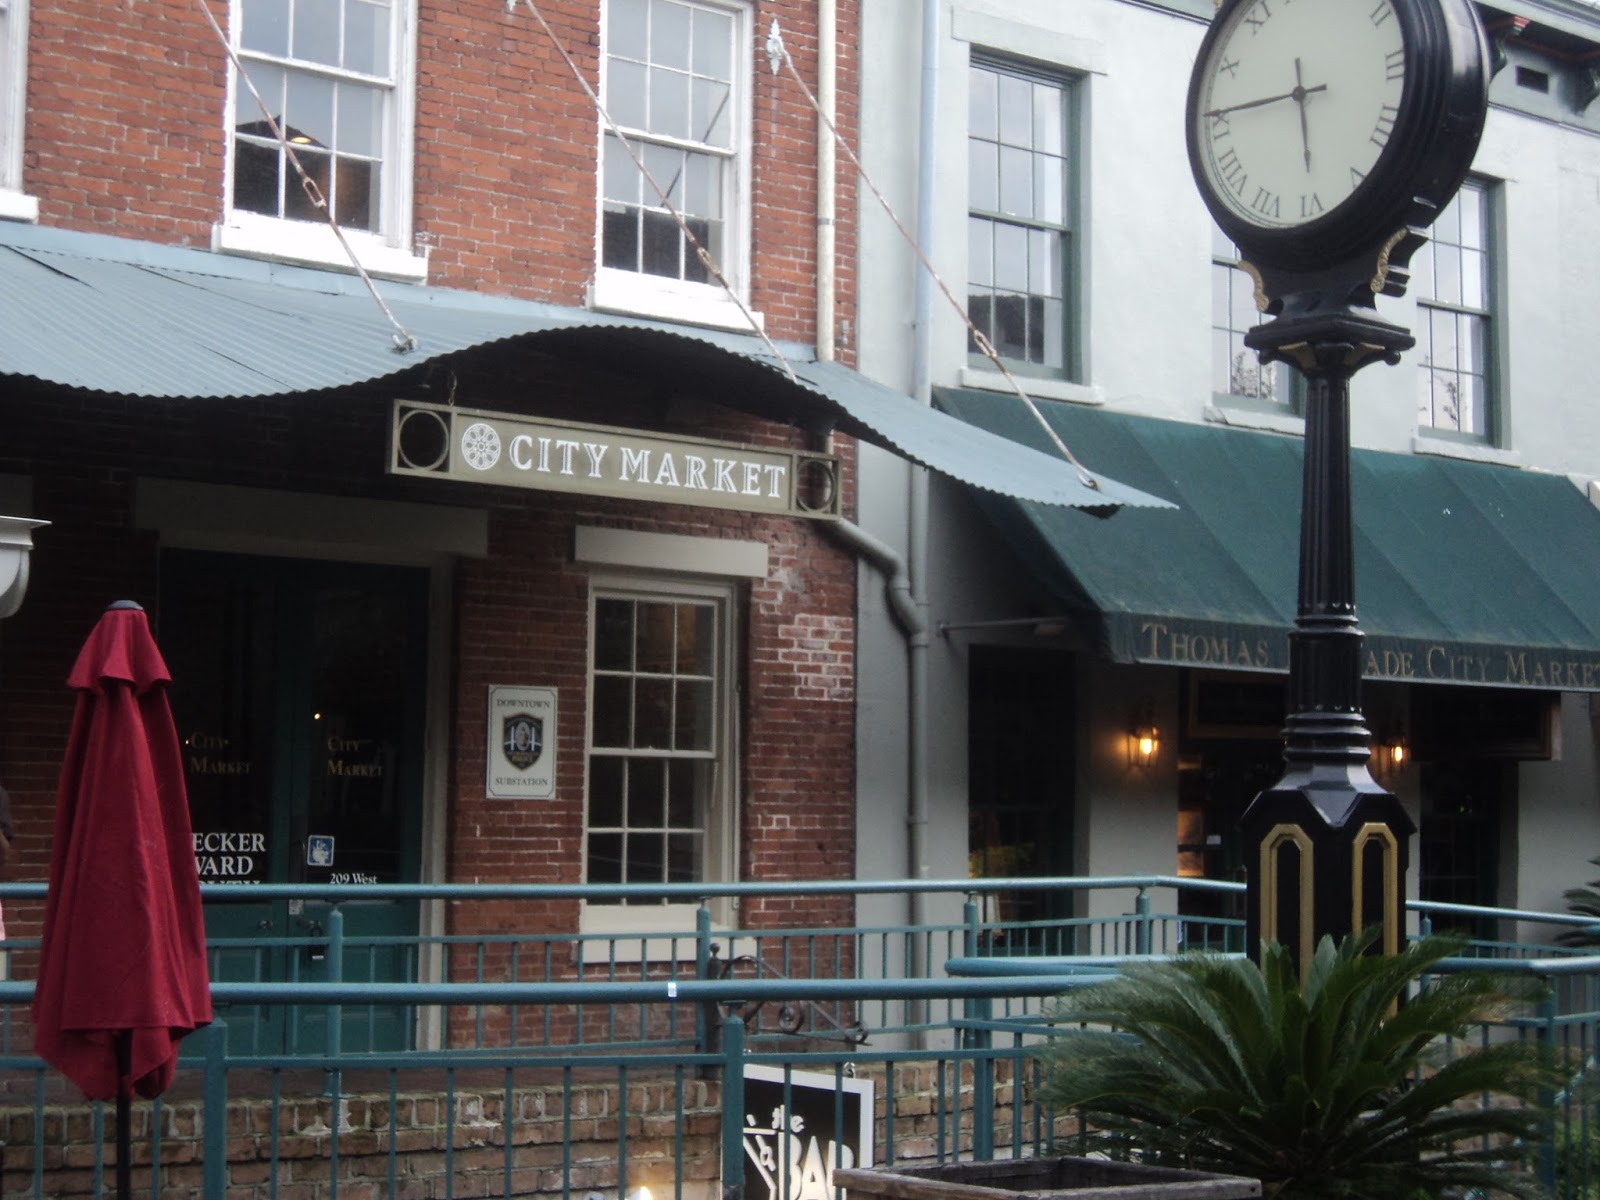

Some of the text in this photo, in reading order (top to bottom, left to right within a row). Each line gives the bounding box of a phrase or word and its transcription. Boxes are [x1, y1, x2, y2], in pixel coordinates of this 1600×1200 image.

[508, 434, 786, 498] CITY MARKET
[1142, 622, 1270, 668] THOMAS
[1426, 646, 1491, 684] CITY
[327, 736, 361, 752] CITY
[327, 758, 384, 777] MARKET
[193, 832, 266, 853] ECKER
[329, 873, 378, 885] 209 West
